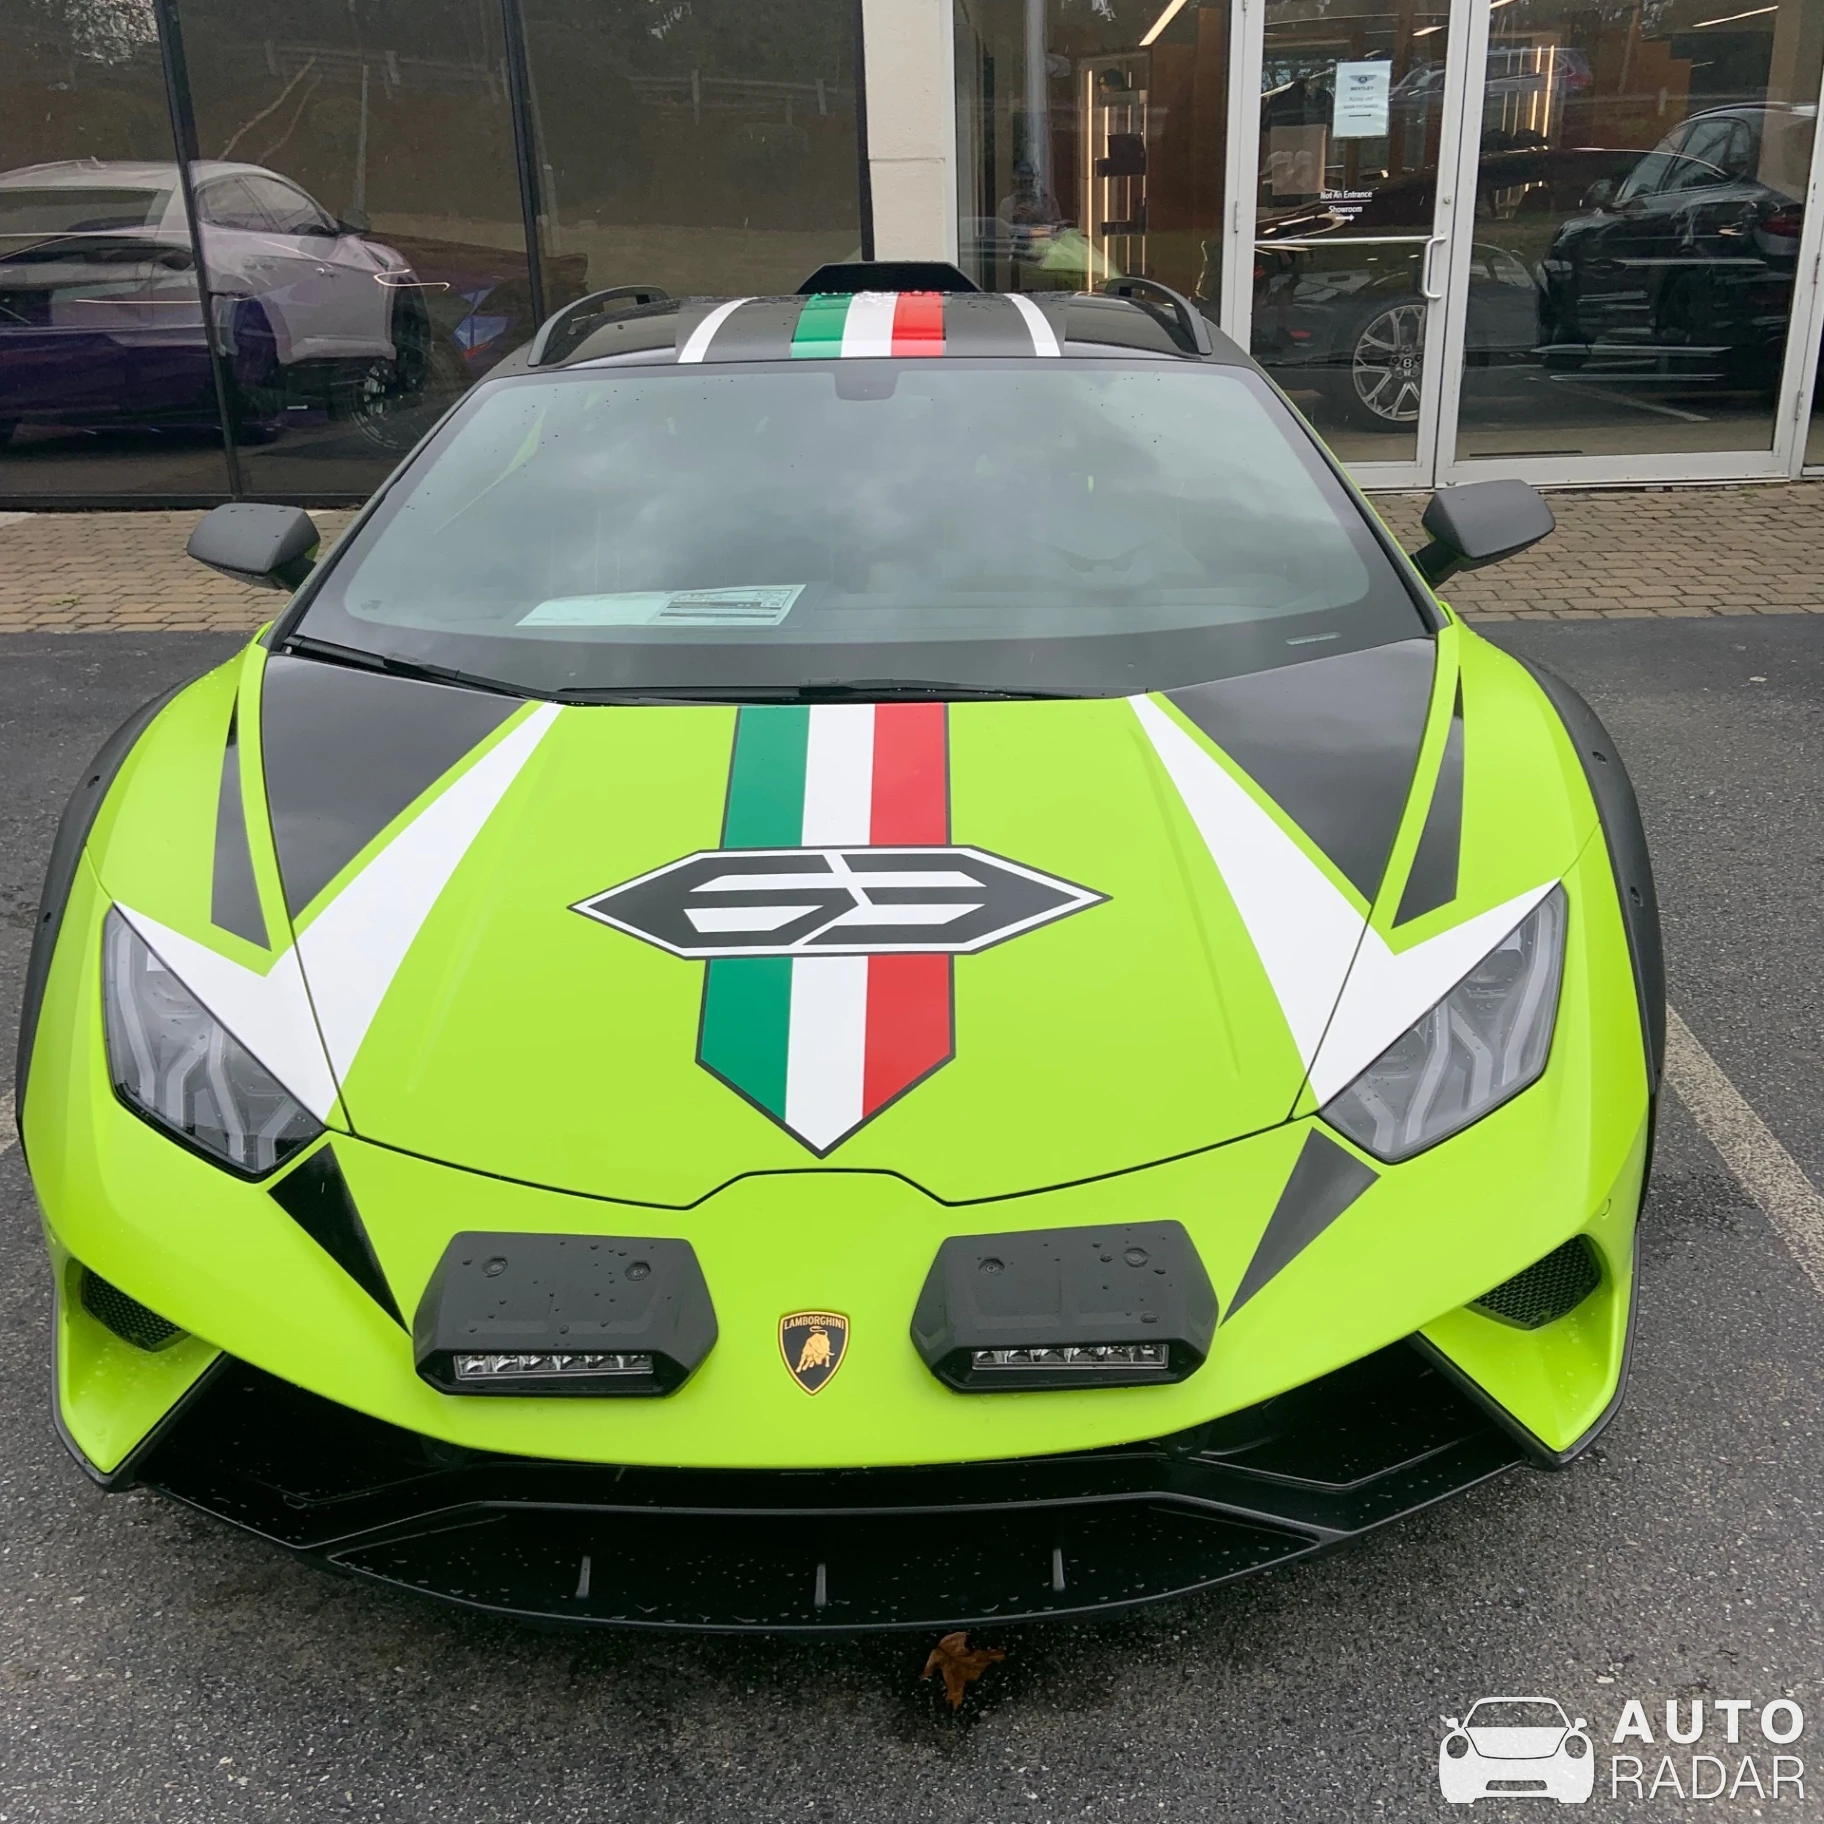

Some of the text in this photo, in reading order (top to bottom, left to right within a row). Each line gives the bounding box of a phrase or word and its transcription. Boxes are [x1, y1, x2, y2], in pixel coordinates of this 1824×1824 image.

[1320, 190, 1373, 199] Not An Entrance
[1328, 205, 1363, 213] Showroom
[784, 1315, 845, 1330] LAMBORGHINI
